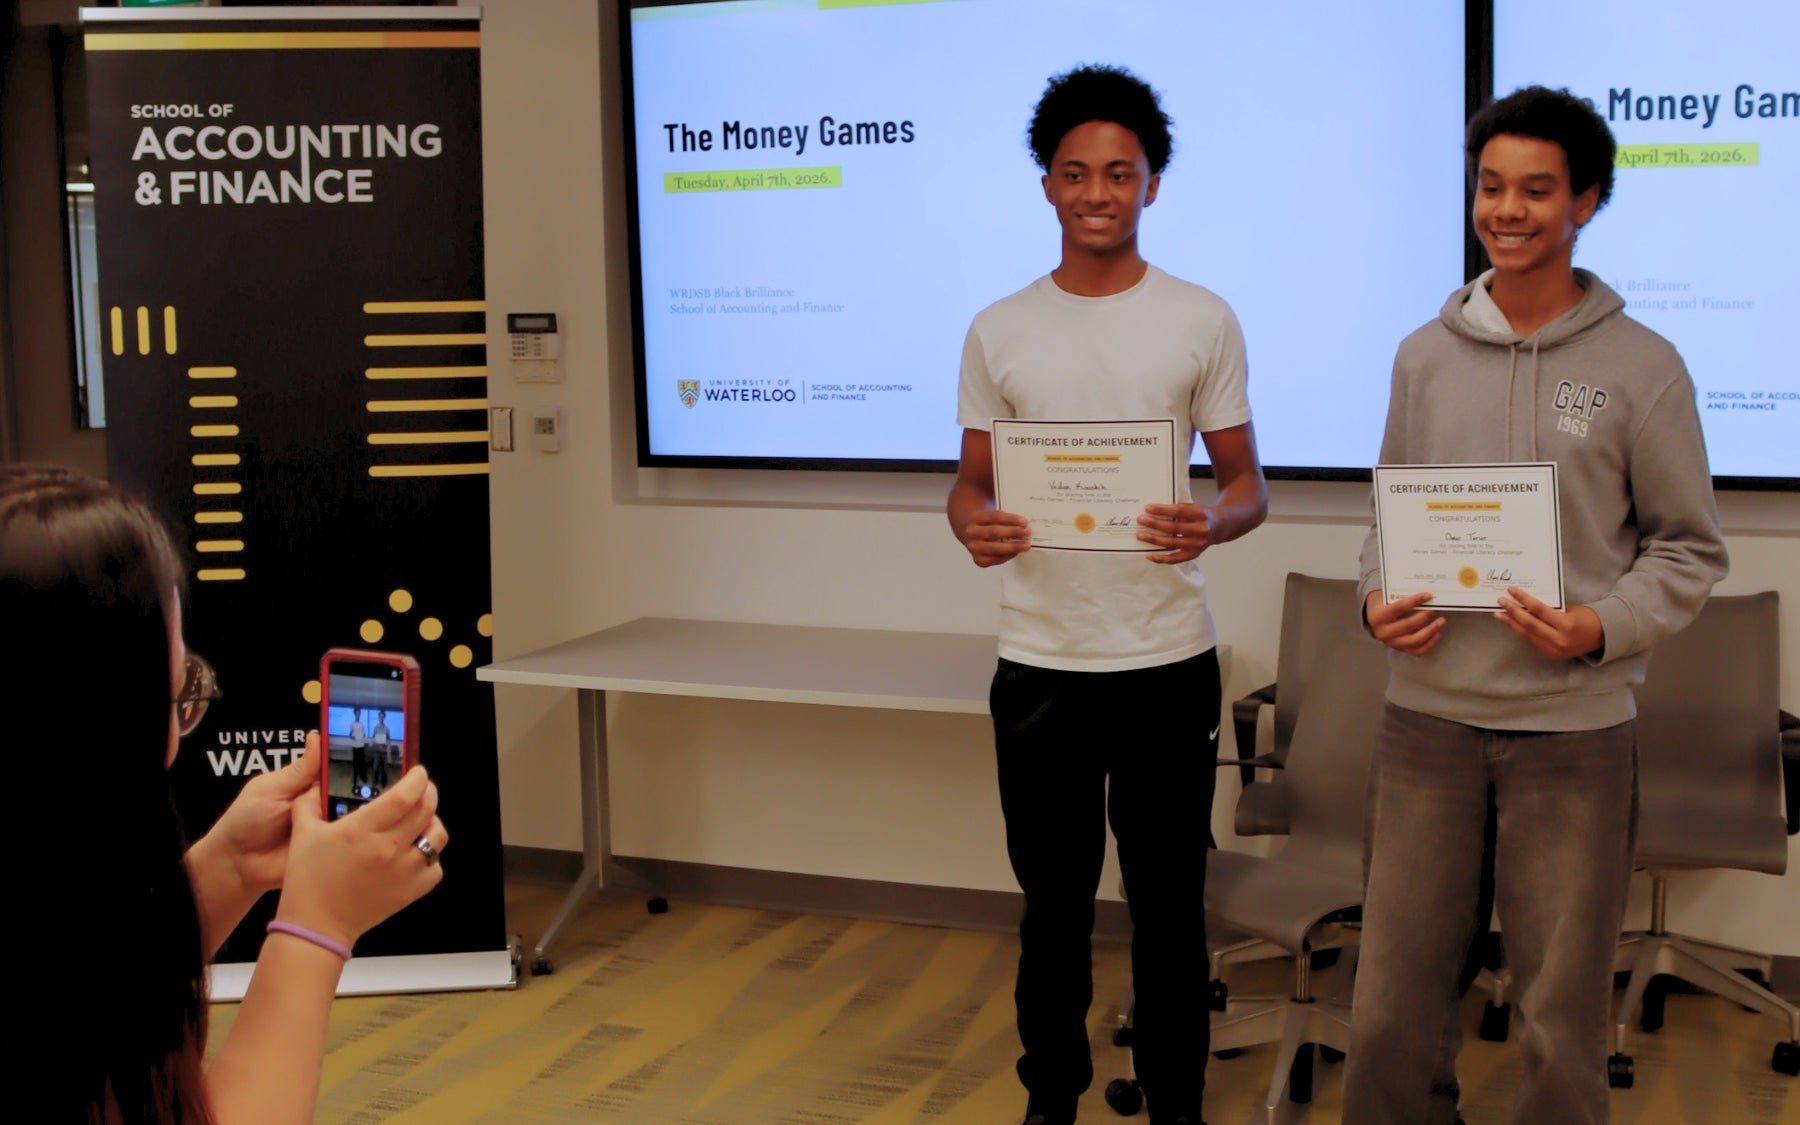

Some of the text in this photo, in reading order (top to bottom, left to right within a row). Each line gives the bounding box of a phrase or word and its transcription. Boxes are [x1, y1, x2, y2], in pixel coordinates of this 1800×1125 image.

[131, 104, 233, 118] SCHOOL OF
[1609, 87, 1721, 129] Money
[131, 124, 442, 160] ACCOUNTING
[663, 116, 916, 155] The Money Games
[1618, 147, 1746, 168] April 7th, 2026.
[134, 168, 373, 206] & FINANCE
[674, 171, 832, 191] Tuesday, April 7th, 2026.
[1627, 279, 1691, 291] Brilliance
[669, 286, 794, 299] WRDSB Black Brilliance
[669, 302, 845, 316] School of Accounting and Finance
[1672, 297, 1697, 309] and
[1702, 297, 1755, 309] Finance
[709, 379, 772, 387] UNIVERSITY
[811, 384, 912, 392] SCHOOL OF ACCOUNTING
[704, 388, 796, 402] WATERLOO
[1552, 378, 1607, 420] GAP
[1707, 392, 1747, 400] SCHOOL
[1750, 392, 1765, 400] OF
[1707, 402, 1777, 410] AND FINANCE
[1556, 415, 1589, 438] 1969
[1007, 436, 1159, 446] CERTIFICATE OF ACHIEVEMENT
[1046, 466, 1120, 474] CONGRATULATIONS
[1389, 483, 1540, 494] CERTIFICATE OF ACHIEVEMENT
[1429, 515, 1501, 523] CONGRATULATIONS
[218, 729, 319, 745] UNIVER
